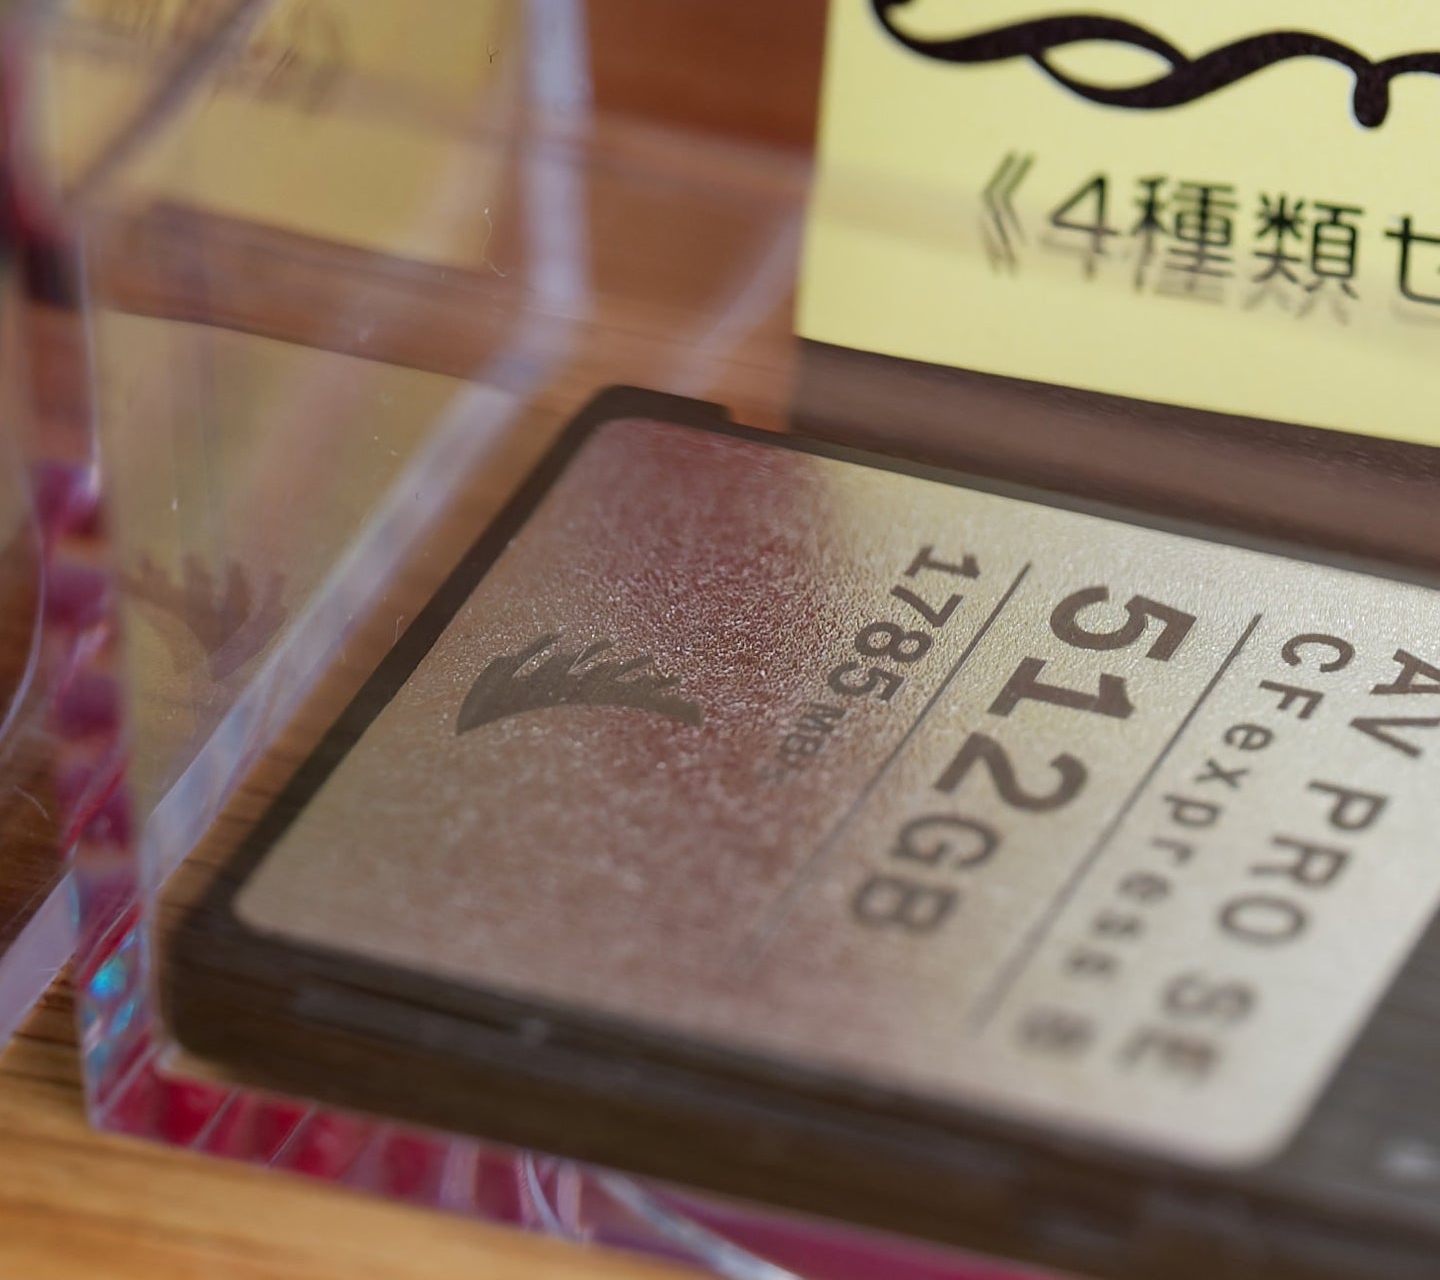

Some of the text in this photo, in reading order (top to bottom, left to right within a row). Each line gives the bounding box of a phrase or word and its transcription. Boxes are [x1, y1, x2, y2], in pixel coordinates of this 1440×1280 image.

[849, 584, 1199, 936] 512GB
[1063, 631, 1357, 983] CFexpress
[1215, 777, 1393, 947] PRO
[1115, 969, 1263, 1088] SE
